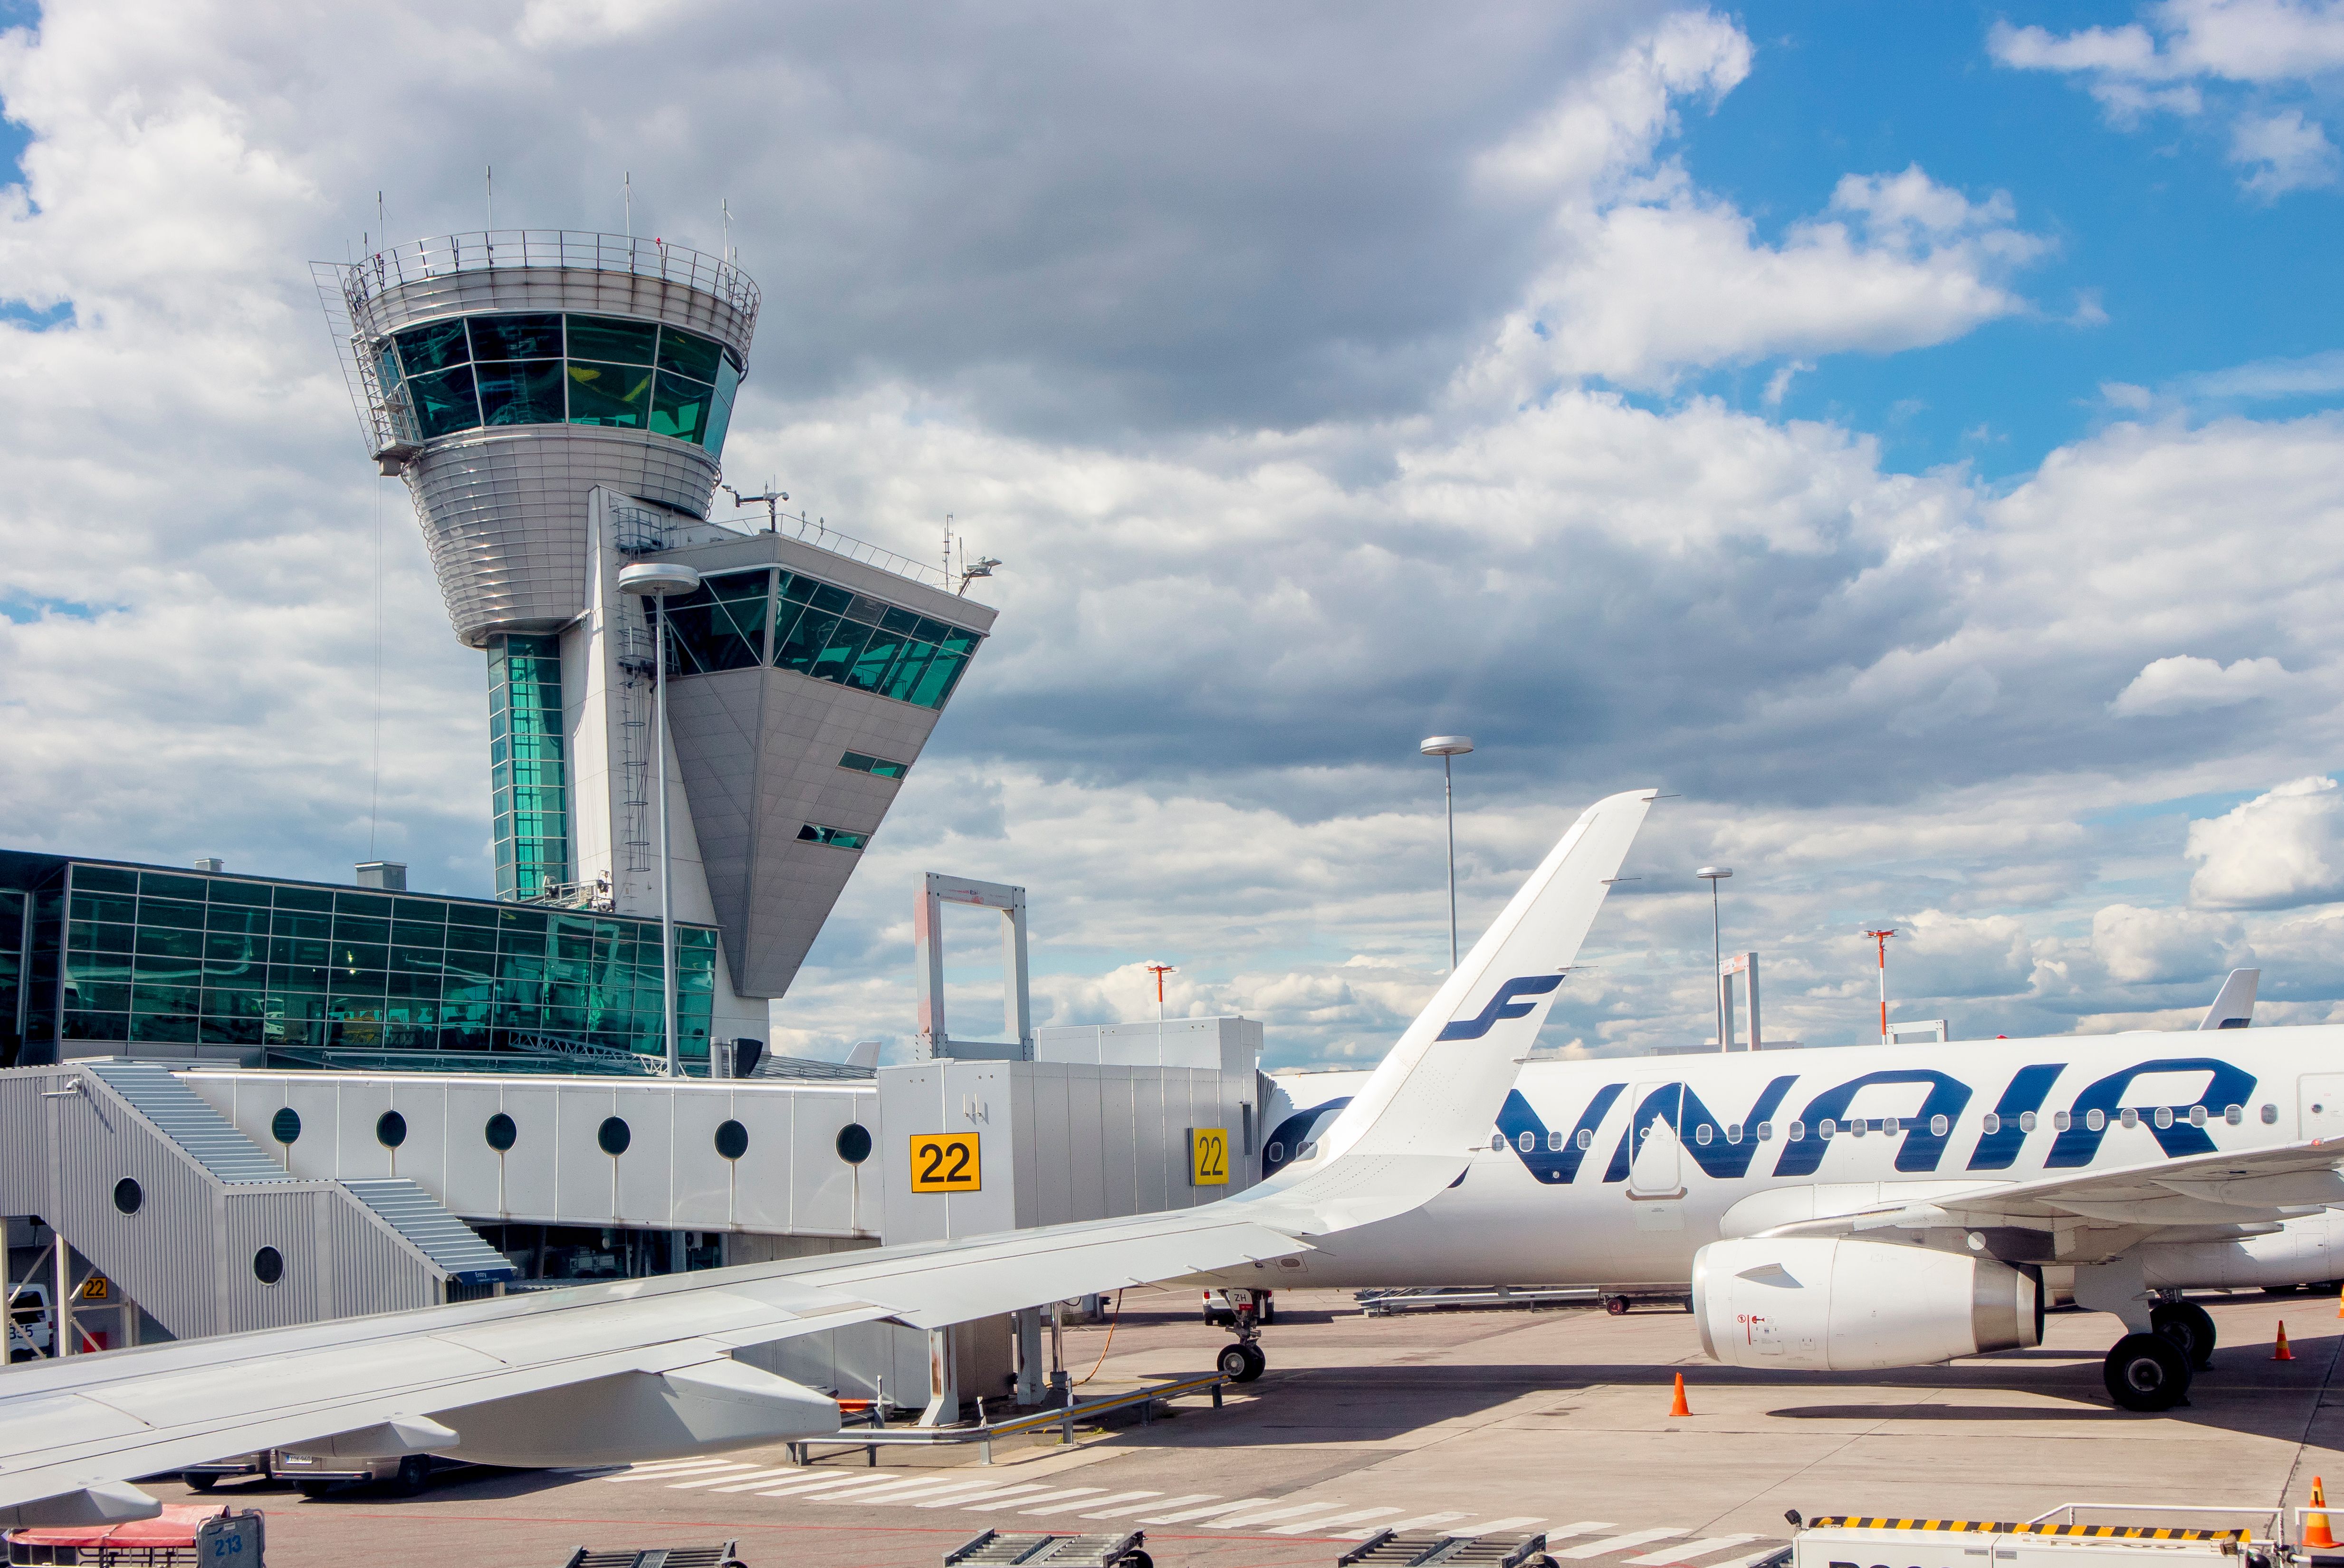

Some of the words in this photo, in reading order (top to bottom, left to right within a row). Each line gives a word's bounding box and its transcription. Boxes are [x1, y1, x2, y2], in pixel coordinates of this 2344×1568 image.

[919, 1142, 972, 1183] 22
[1199, 1136, 1224, 1176] 22
[86, 1280, 105, 1297] 22
[1234, 1294, 1247, 1302] ZH
[215, 1535, 243, 1557] 213
